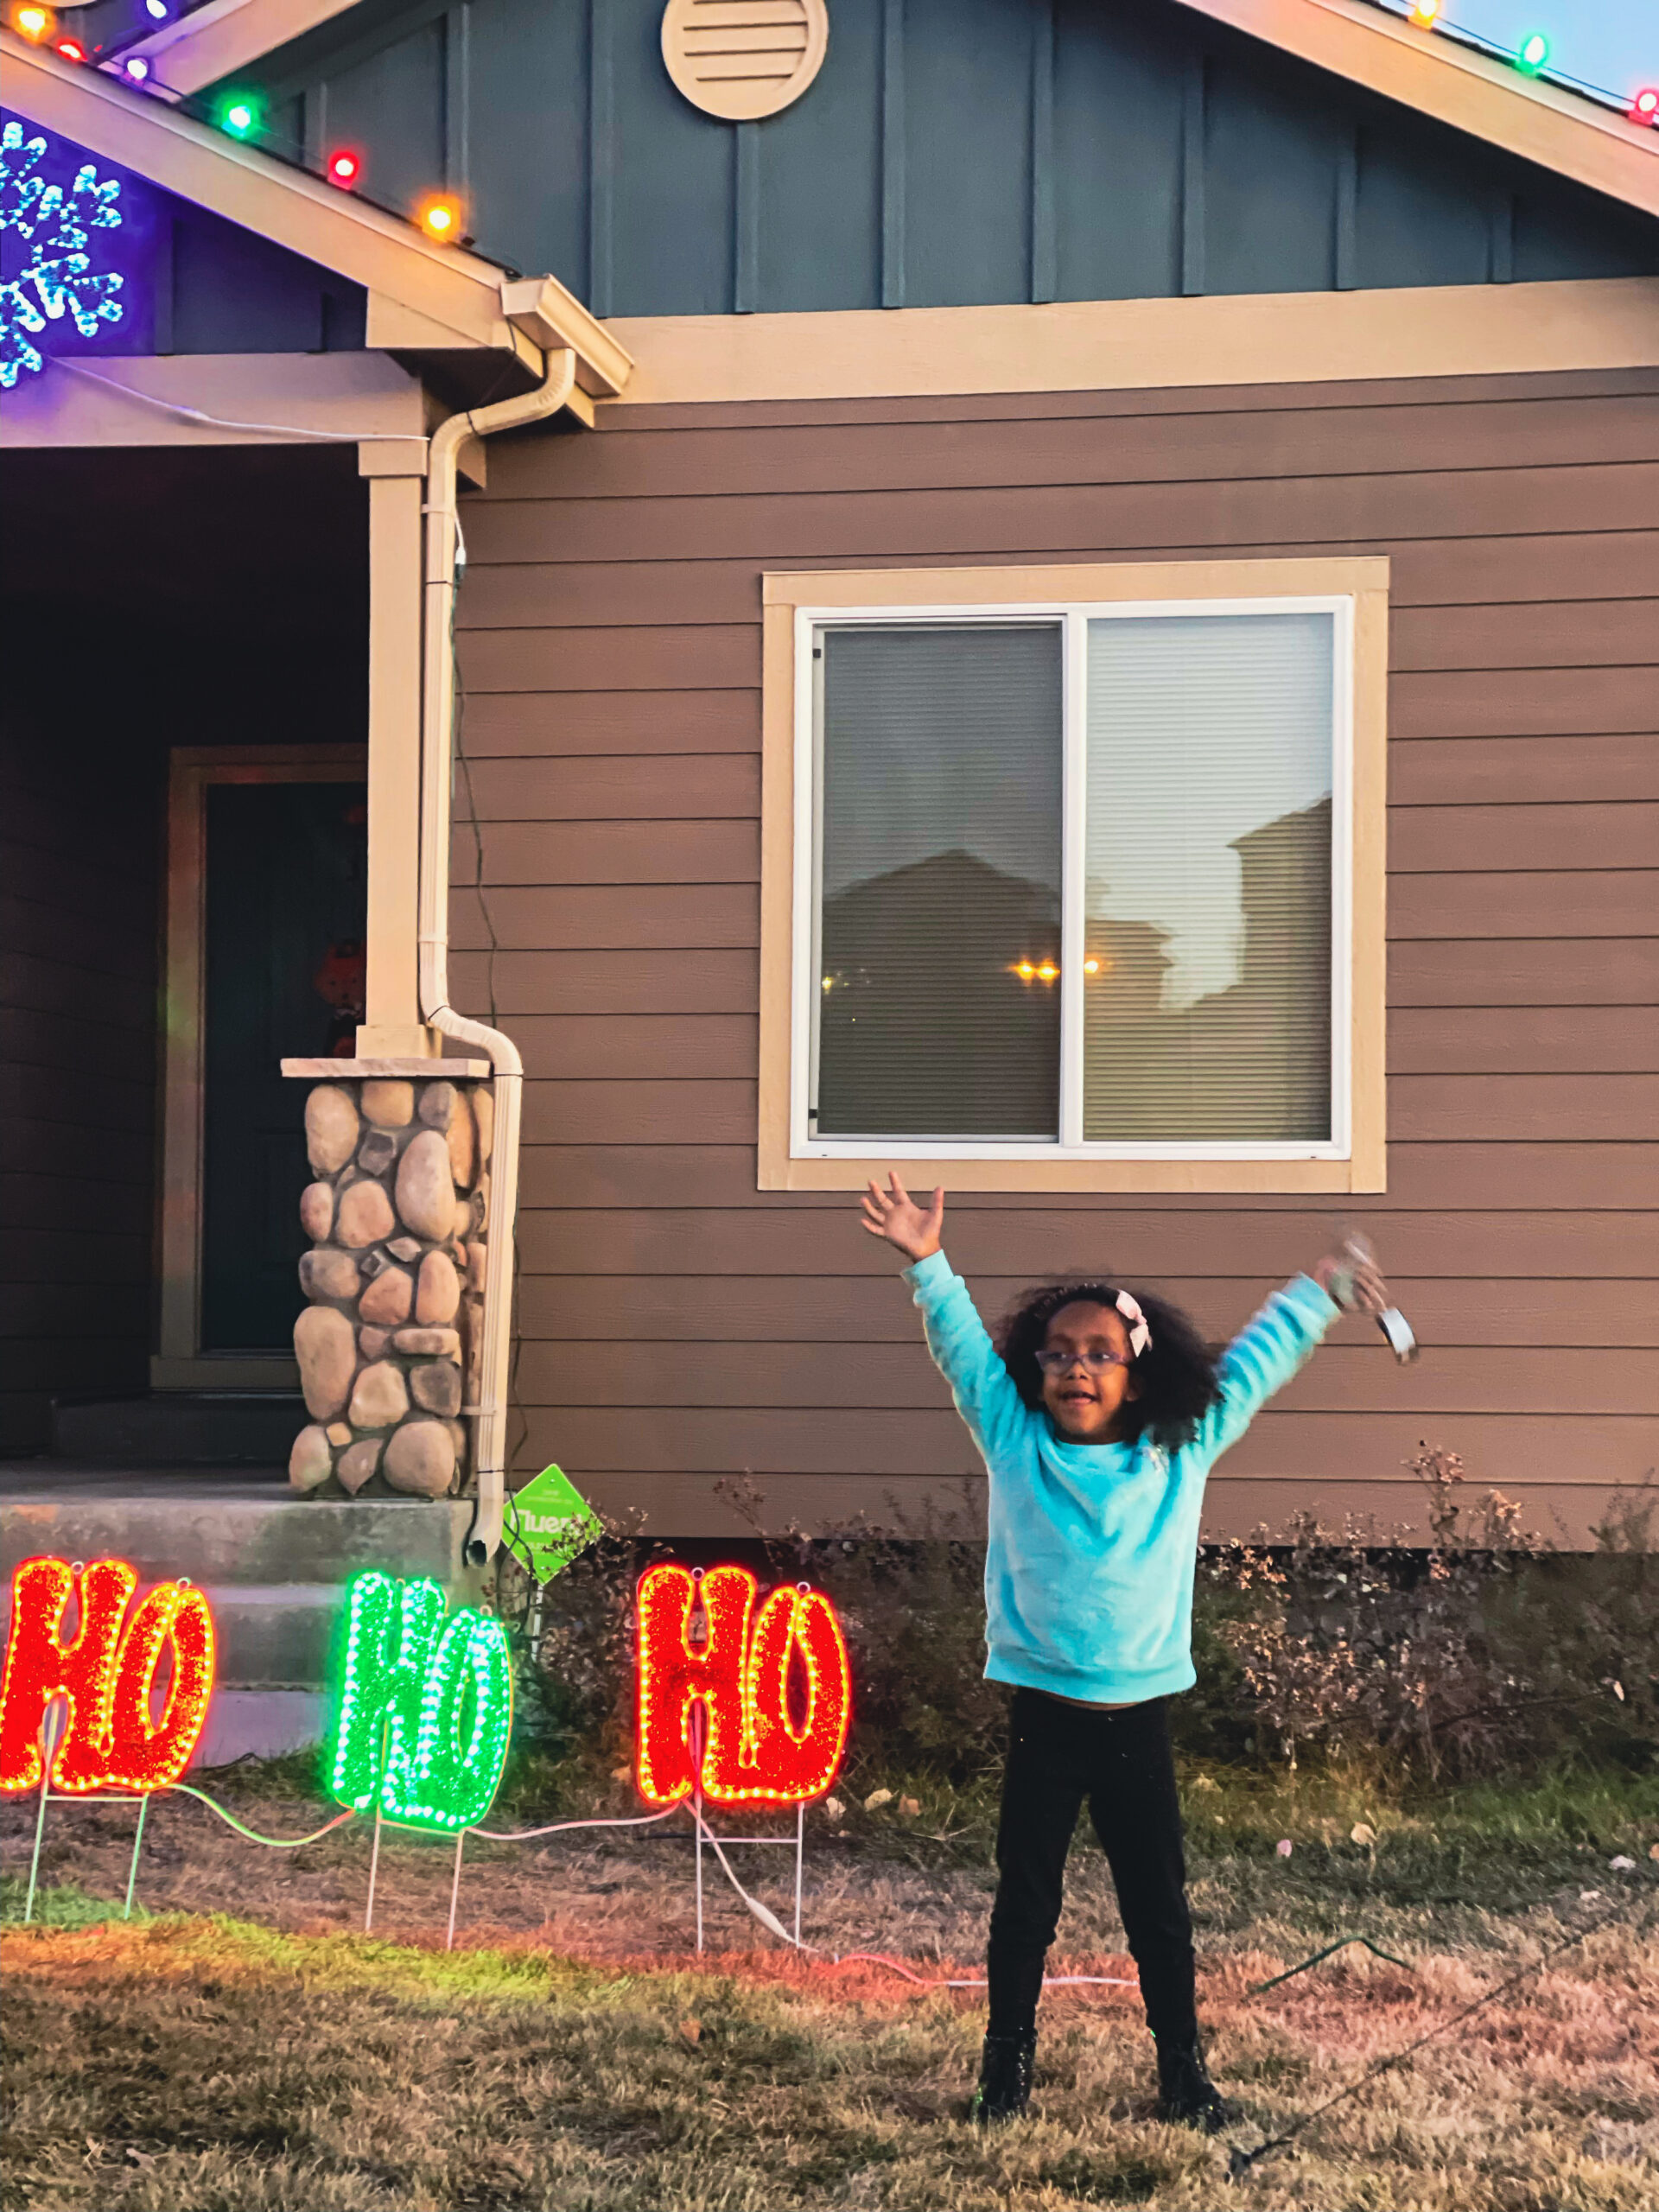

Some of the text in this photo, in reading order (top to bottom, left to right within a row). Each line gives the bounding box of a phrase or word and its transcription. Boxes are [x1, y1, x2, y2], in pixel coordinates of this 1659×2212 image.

[0, 1557, 851, 1828] HO HO HO
